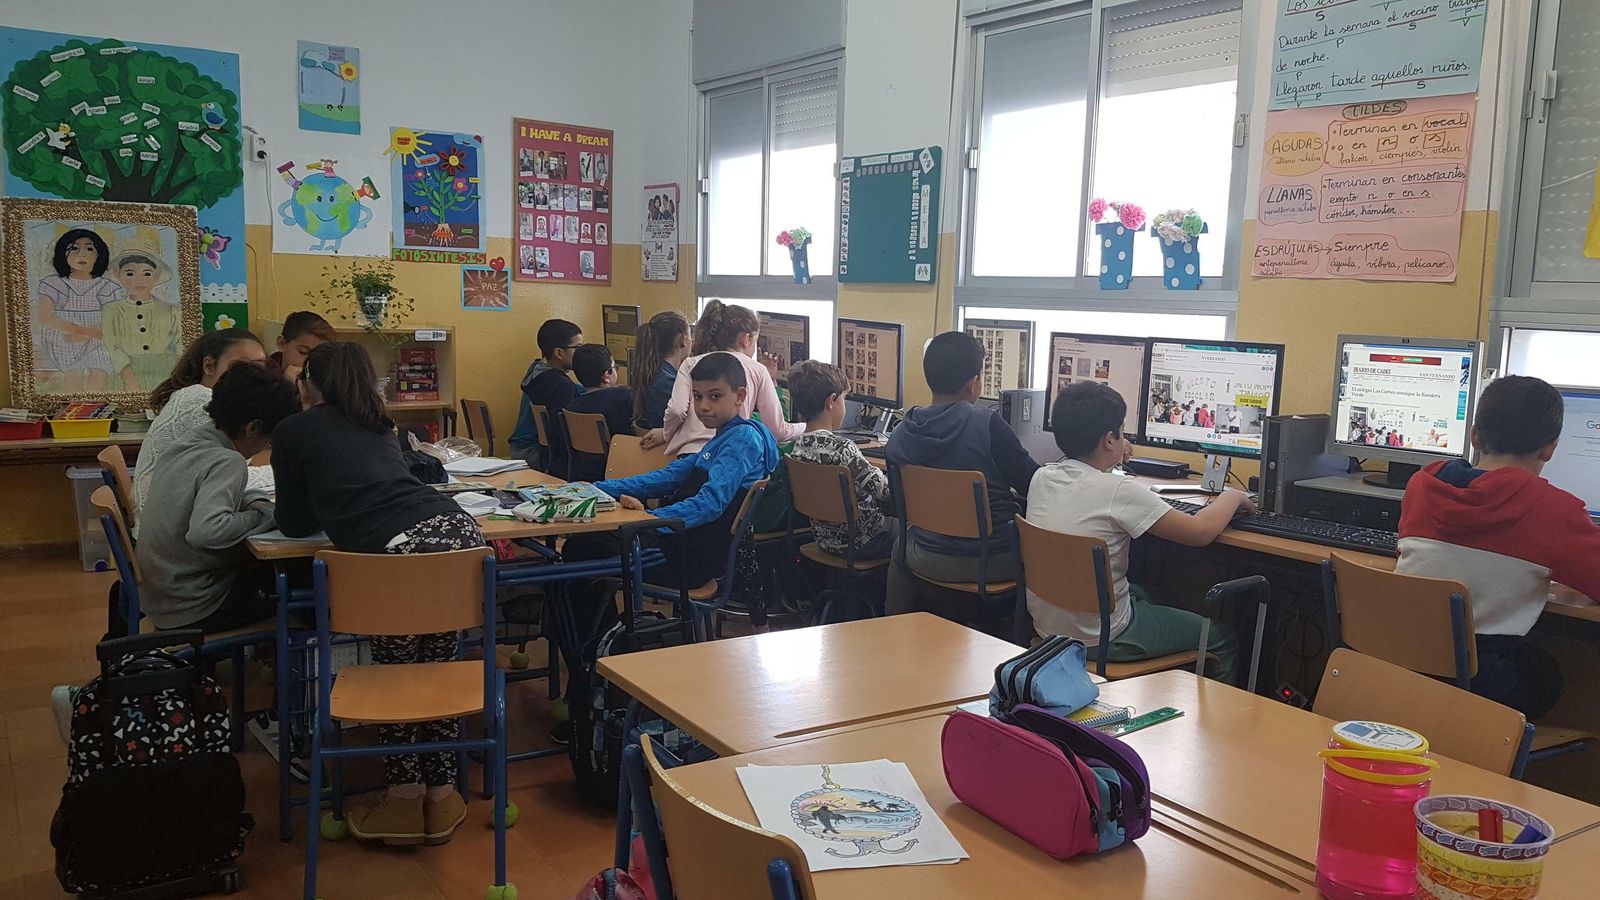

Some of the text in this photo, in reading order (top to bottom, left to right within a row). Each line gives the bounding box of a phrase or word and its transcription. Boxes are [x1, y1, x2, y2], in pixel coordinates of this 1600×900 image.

[1315, 11, 1325, 21] S
[1279, 28, 1318, 49] Durante
[1324, 24, 1335, 37] la
[1339, 20, 1381, 35] semana
[1402, 5, 1439, 20] vecino
[1408, 22, 1417, 30] S
[1276, 58, 1287, 72] de
[1330, 69, 1366, 87] tarde
[1371, 63, 1423, 89] aquellos
[1417, 80, 1425, 89] S
[1350, 102, 1402, 117] TILDES
[1337, 113, 1467, 136] Terminan en vocal
[521, 126, 609, 147] I HAVE A DREAM
[1272, 138, 1323, 154] AGUDAS
[1352, 142, 1367, 150] en
[1326, 177, 1377, 191] Terminan
[1382, 176, 1396, 184] en
[1267, 187, 1313, 203] LLANAS
[1402, 190, 1415, 198] en
[1255, 240, 1389, 262] ESDRÚJULAS Siempre
[481, 282, 498, 291] PAZ
